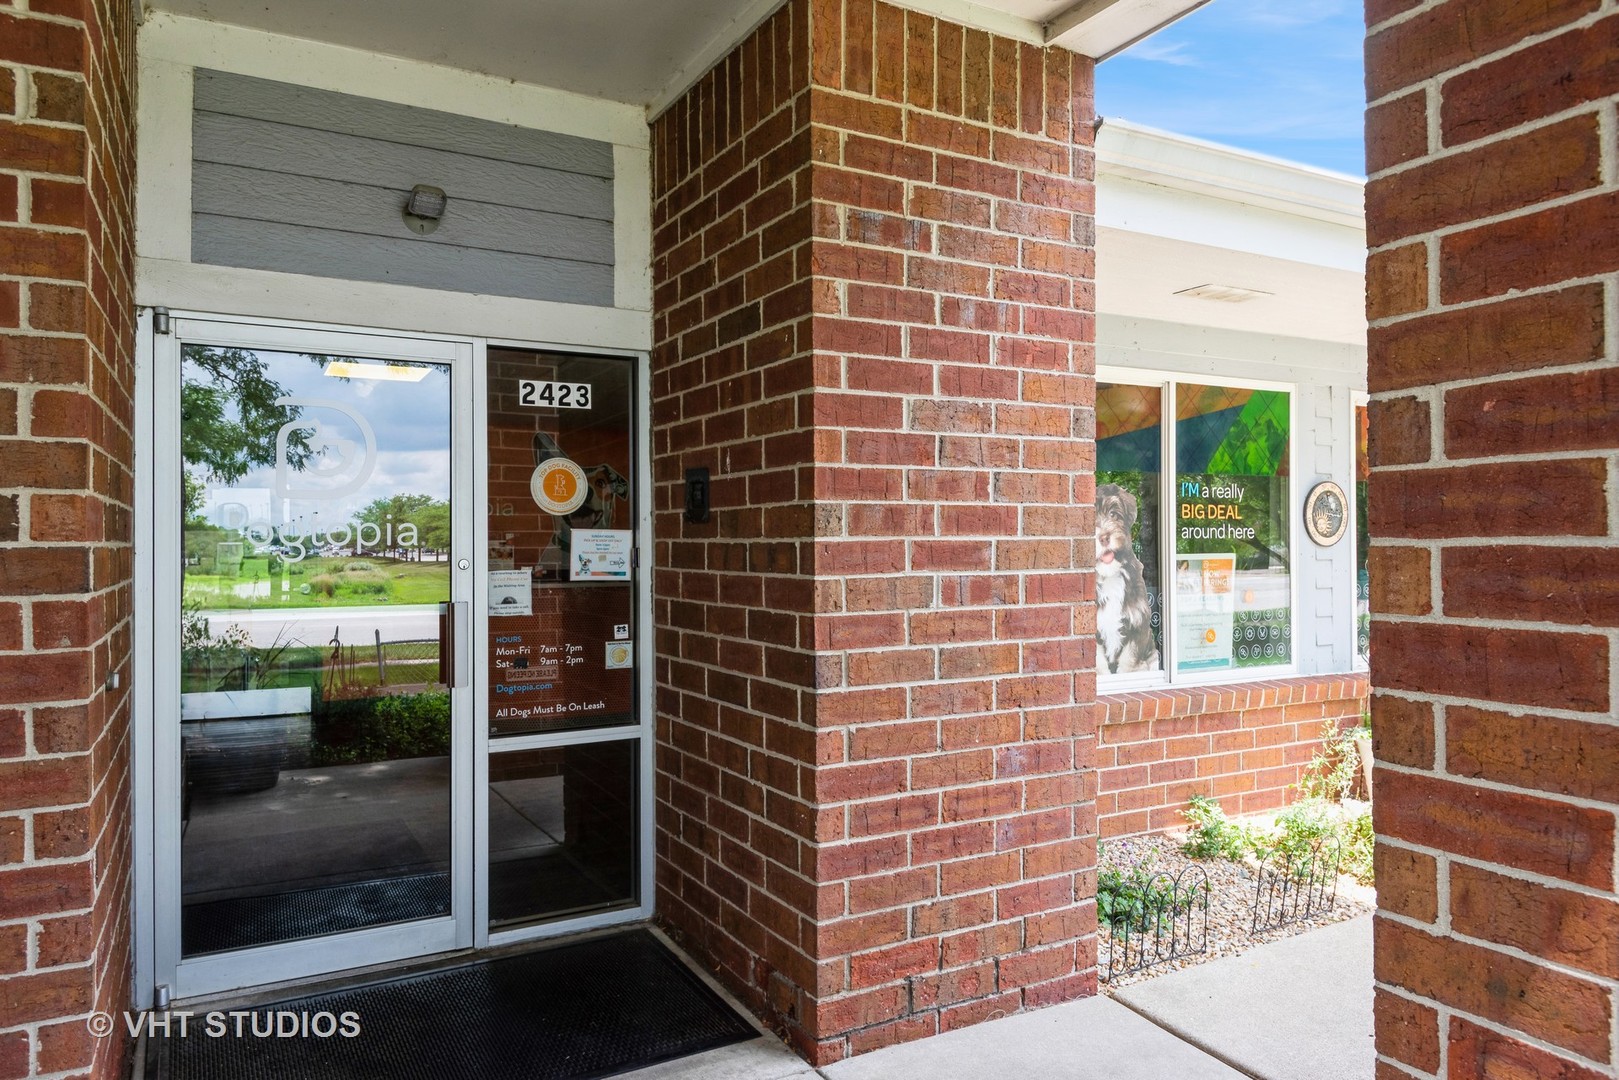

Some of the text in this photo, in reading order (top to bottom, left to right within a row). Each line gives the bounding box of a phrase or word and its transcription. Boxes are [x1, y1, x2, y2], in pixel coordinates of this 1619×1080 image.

[521, 382, 590, 407] 2423
[1181, 482, 1245, 502] I'M a really
[1181, 504, 1243, 520] BIG DEAL
[247, 514, 418, 563] ogtopia
[1181, 524, 1255, 539] around here
[496, 635, 522, 643] HOURS
[496, 645, 531, 656] Mon-Fri
[540, 644, 558, 654] 7am
[565, 644, 583, 655] 7pm
[496, 658, 529, 669] Sat-
[540, 656, 558, 665] 9am
[566, 655, 584, 666] 2pm
[496, 681, 553, 695] Dogtopia.com
[496, 701, 605, 718] All Dogs Must Be On Leash
